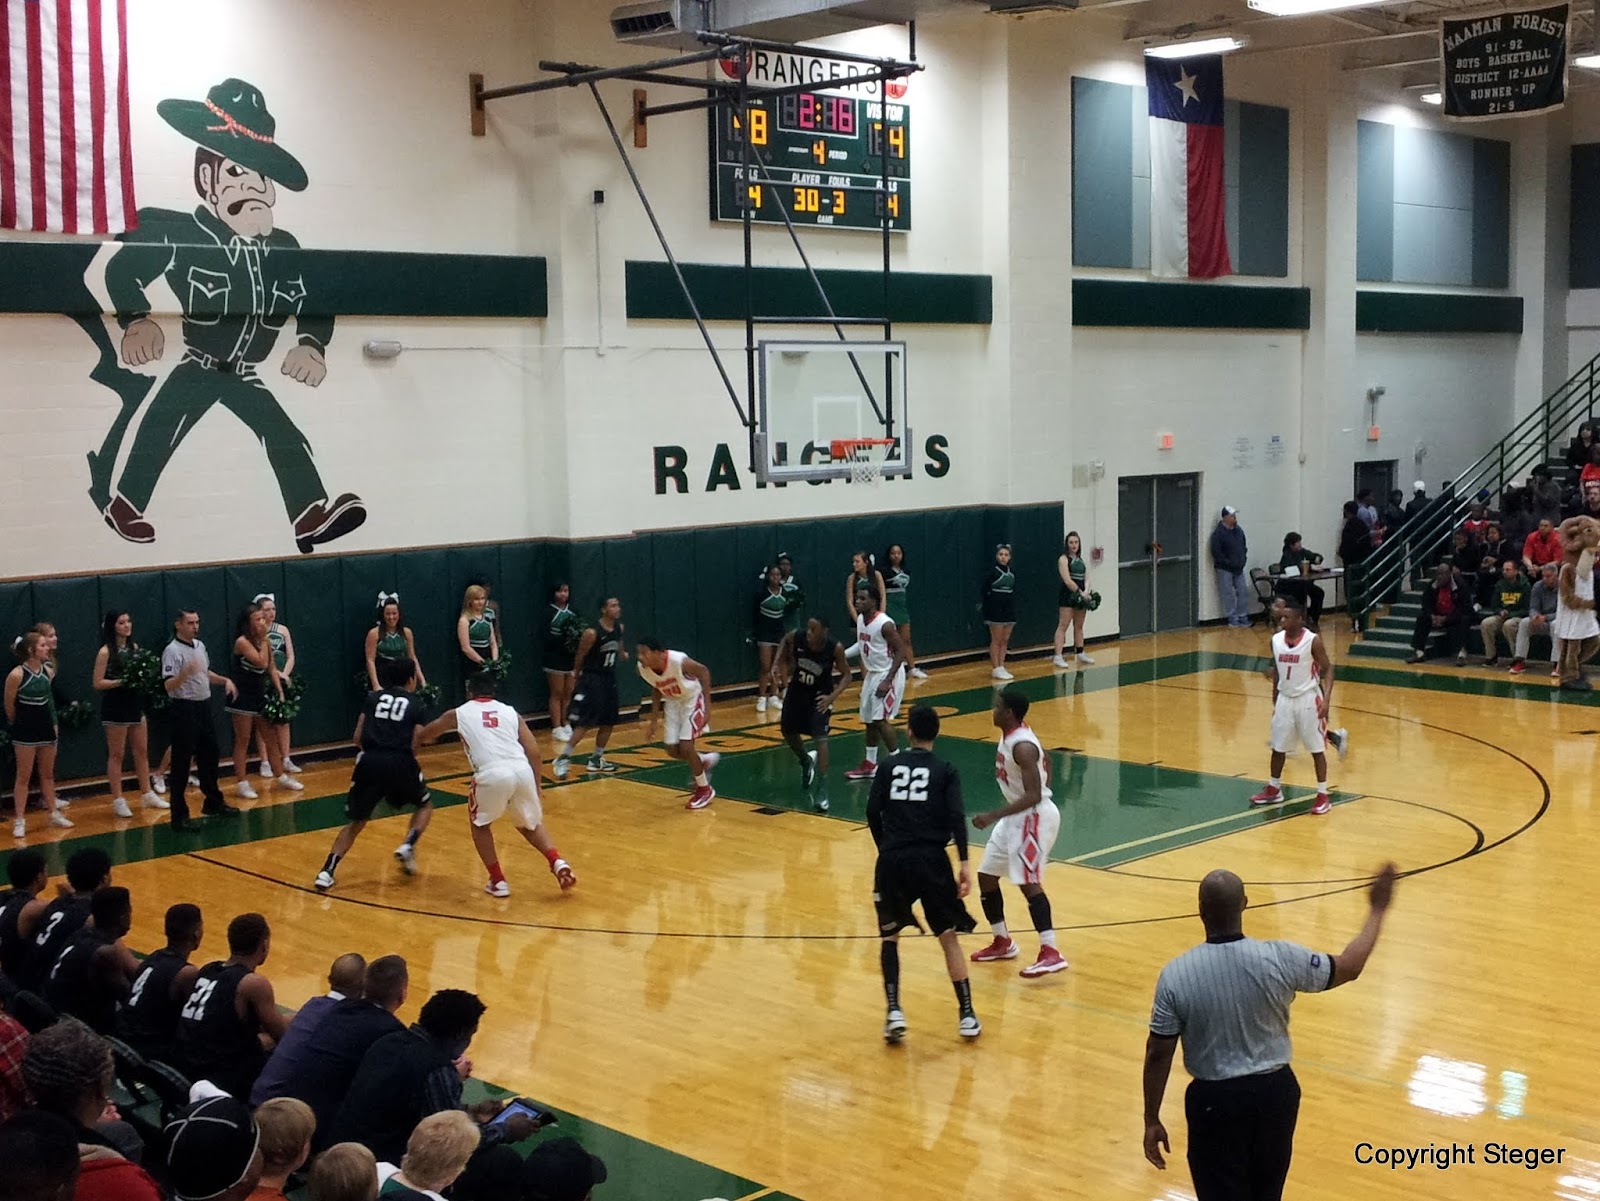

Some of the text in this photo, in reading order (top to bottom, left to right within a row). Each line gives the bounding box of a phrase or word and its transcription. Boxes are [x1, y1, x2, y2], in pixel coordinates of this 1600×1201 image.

[1444, 14, 1564, 51] NAAMAN FOREST
[1456, 48, 1551, 69] BOYS BASKETBALL
[1454, 71, 1500, 84] DISTRICT
[800, 94, 853, 132] 2:16
[866, 102, 904, 121] VISTOR
[813, 140, 825, 165] 4
[792, 172, 851, 187] PLAYER FOULS
[748, 185, 761, 208] 4
[888, 194, 899, 217] 4
[817, 214, 834, 225] GAME
[374, 693, 409, 721] 20
[482, 710, 499, 728] 5
[889, 765, 930, 802] 22
[181, 976, 219, 1021] 21
